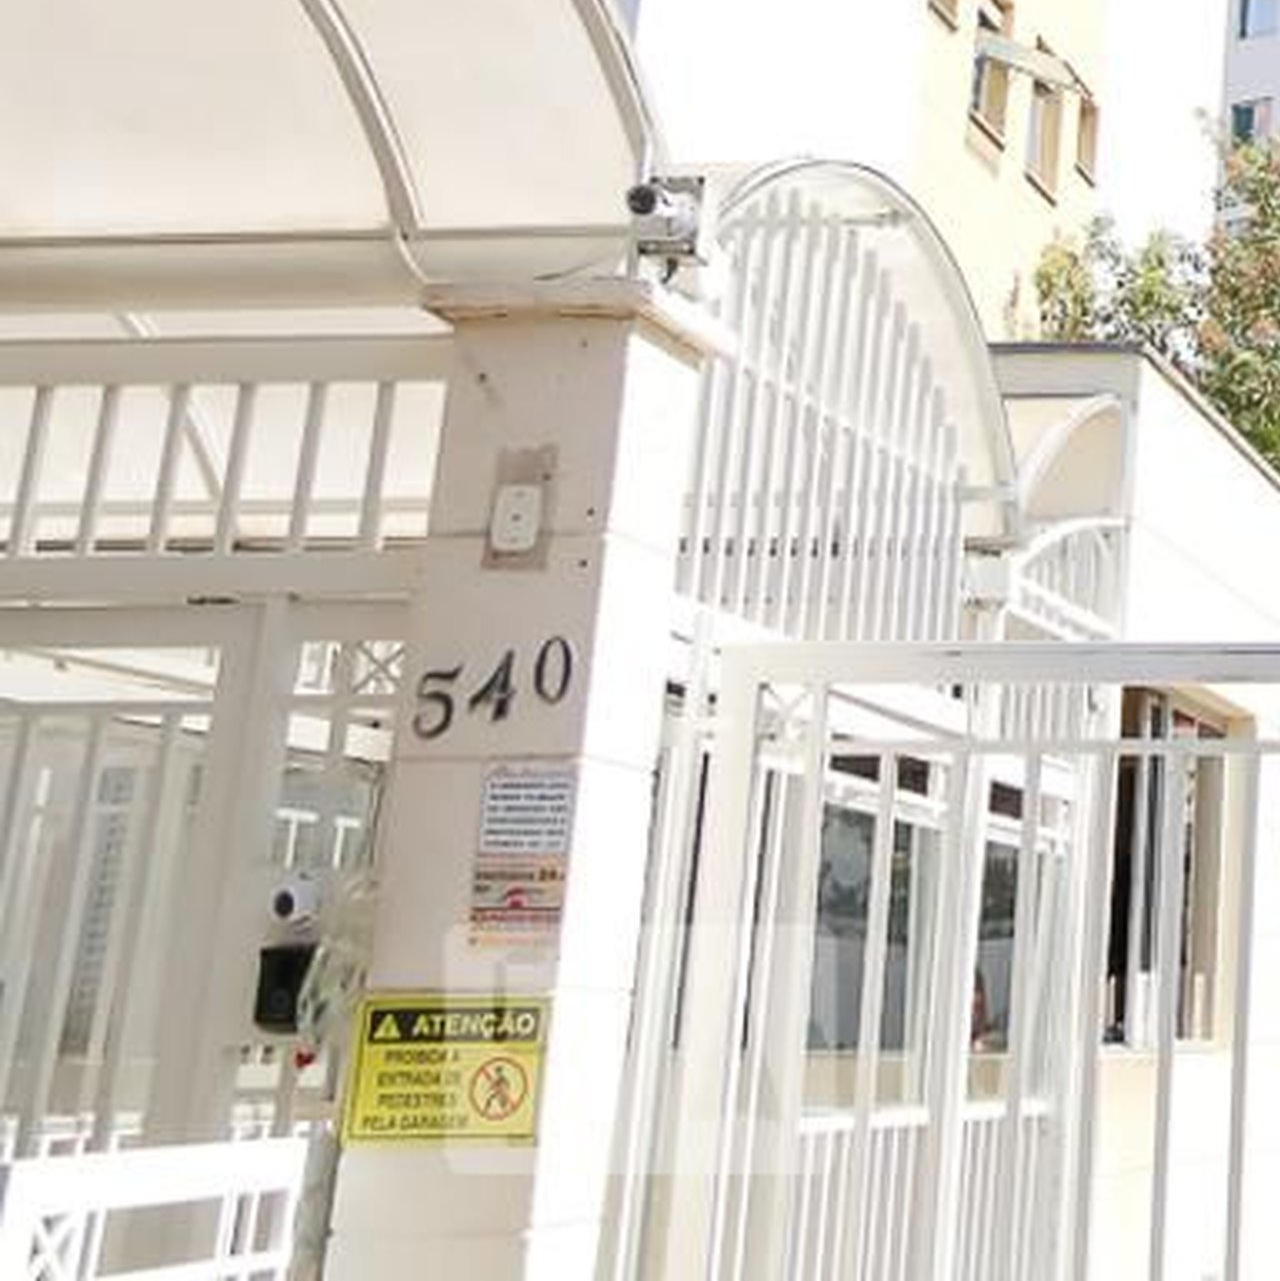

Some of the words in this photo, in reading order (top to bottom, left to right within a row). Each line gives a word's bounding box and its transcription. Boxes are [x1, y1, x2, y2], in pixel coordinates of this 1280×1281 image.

[413, 636, 572, 740] 540
[411, 1011, 536, 1039] ATENÇÃO
[376, 1070, 442, 1088] ENTRADA
[361, 1115, 396, 1131] PELA
